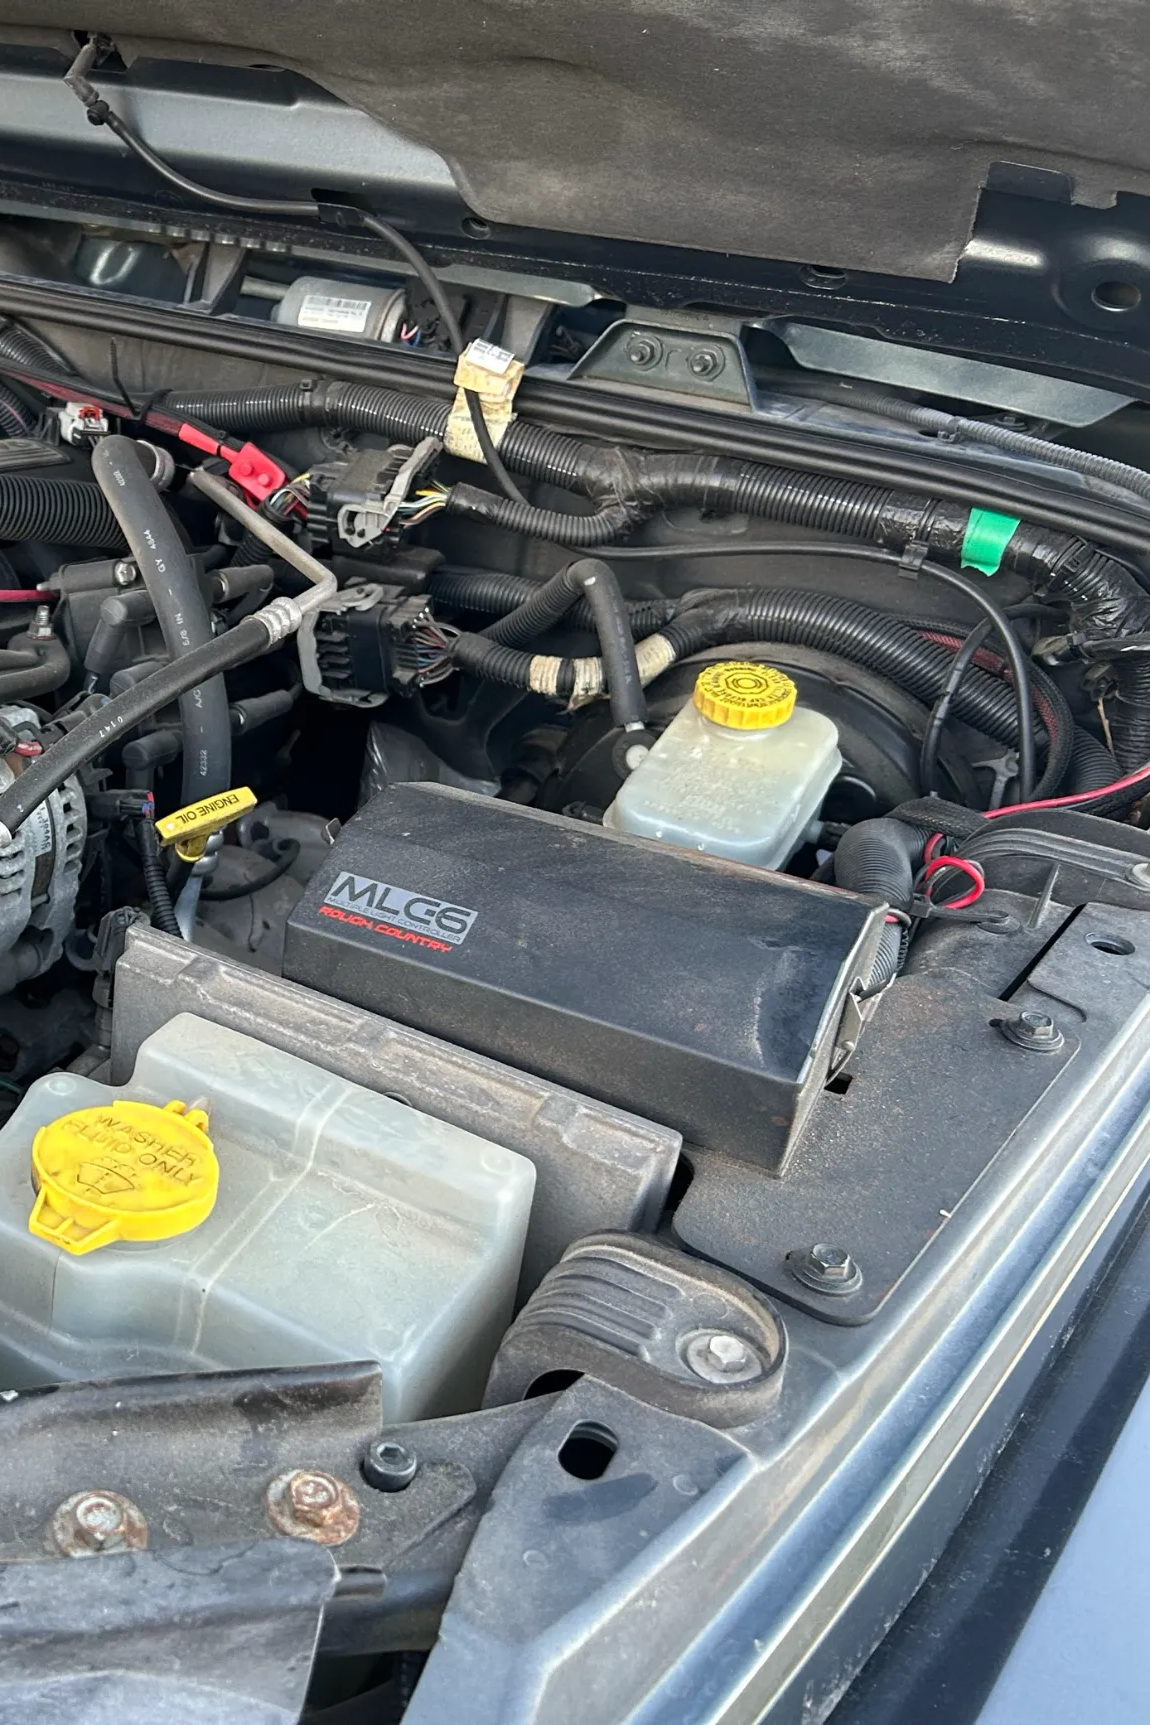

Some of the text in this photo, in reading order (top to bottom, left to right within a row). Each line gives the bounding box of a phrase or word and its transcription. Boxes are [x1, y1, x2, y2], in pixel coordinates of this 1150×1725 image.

[155, 558, 167, 573] GY
[174, 612, 185, 625] IN
[192, 689, 203, 709] A/C
[175, 794, 240, 824] ENGINE OIL
[318, 905, 454, 953] ROUGH COUNTRY
[367, 907, 397, 922] LIGHT
[397, 916, 462, 942] CONTROLLER
[62, 1119, 203, 1187] FLUID ONLY
[95, 1115, 200, 1167] WASHER
